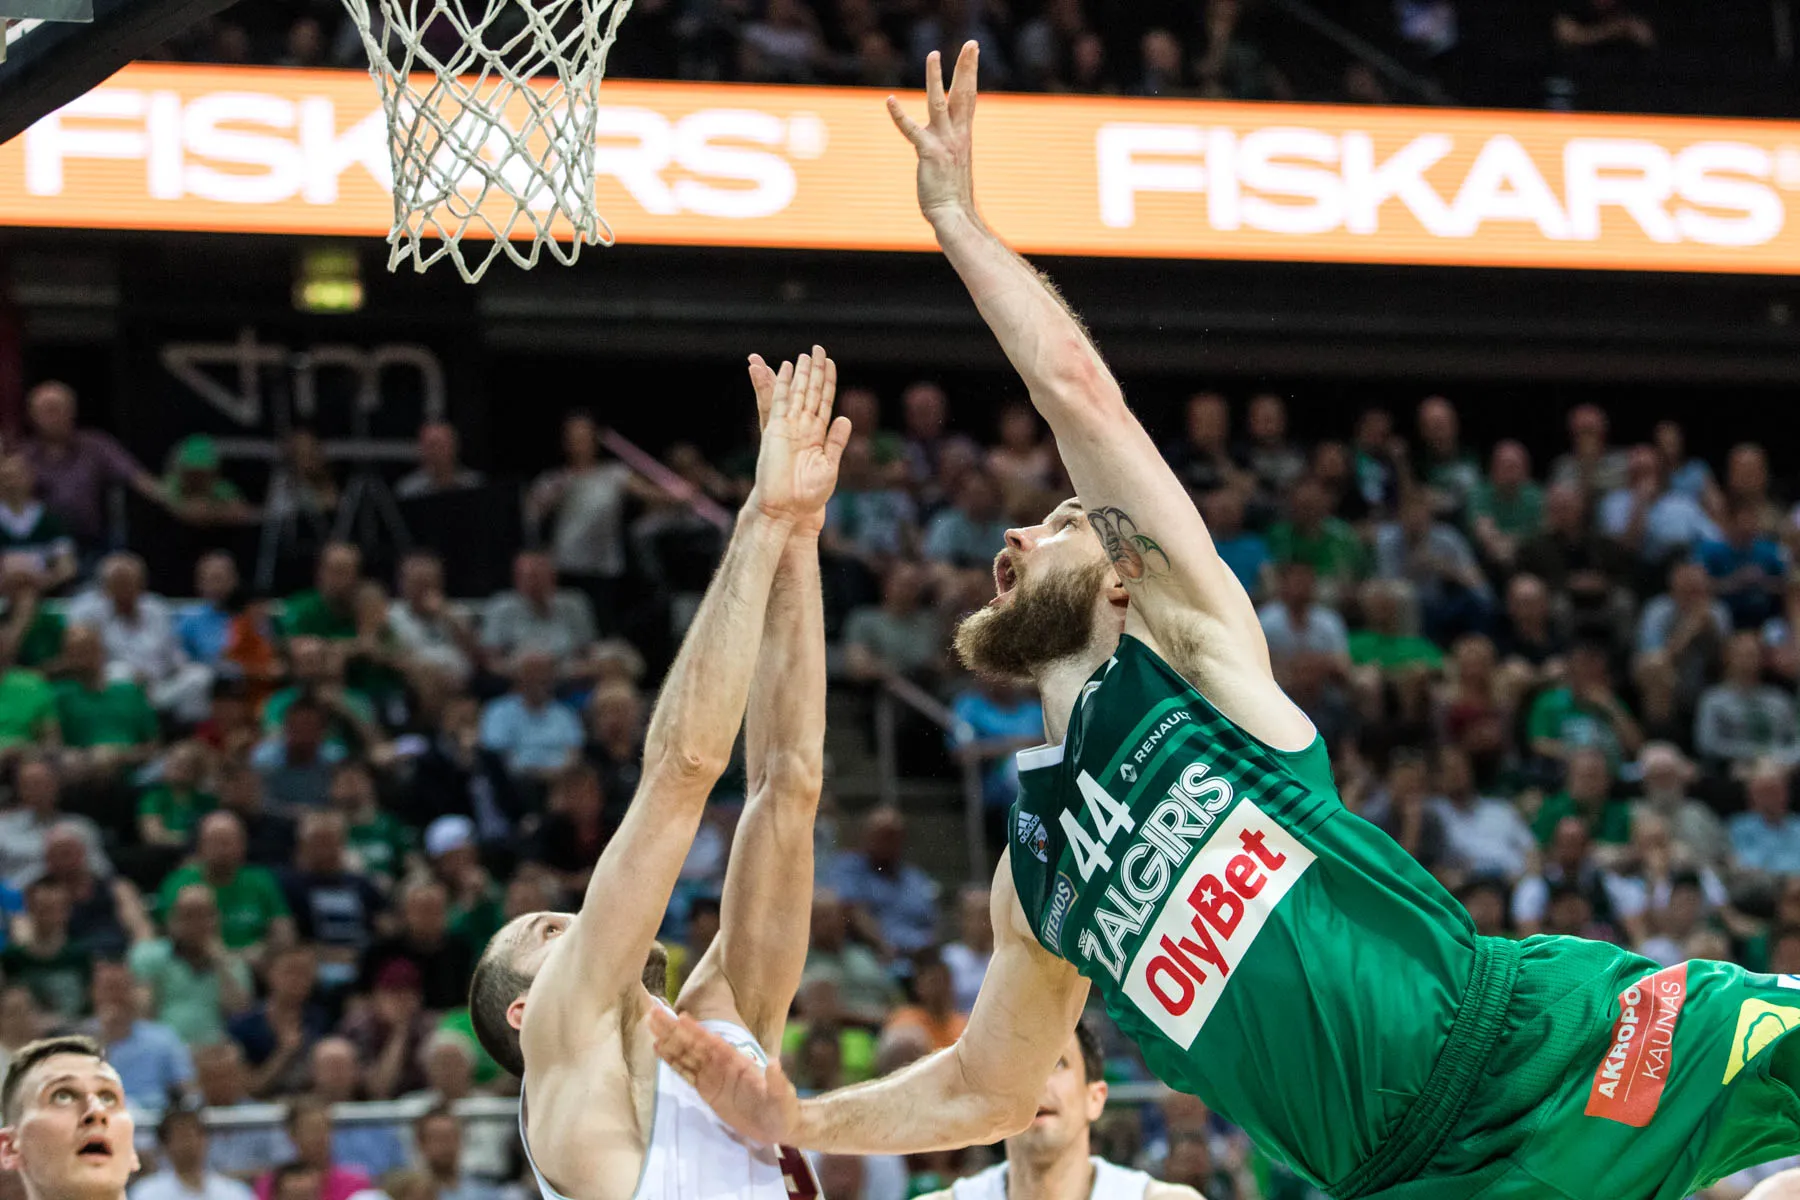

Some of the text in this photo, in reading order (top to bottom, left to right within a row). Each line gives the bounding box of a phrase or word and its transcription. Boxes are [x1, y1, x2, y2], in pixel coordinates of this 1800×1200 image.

[1096, 124, 1784, 247] FISKARS
[1058, 768, 1136, 884] 44
[1078, 761, 1233, 983] ŽALGIRIS
[1145, 827, 1287, 1016] OlyBet
[1641, 981, 1681, 1080] KAUNAS
